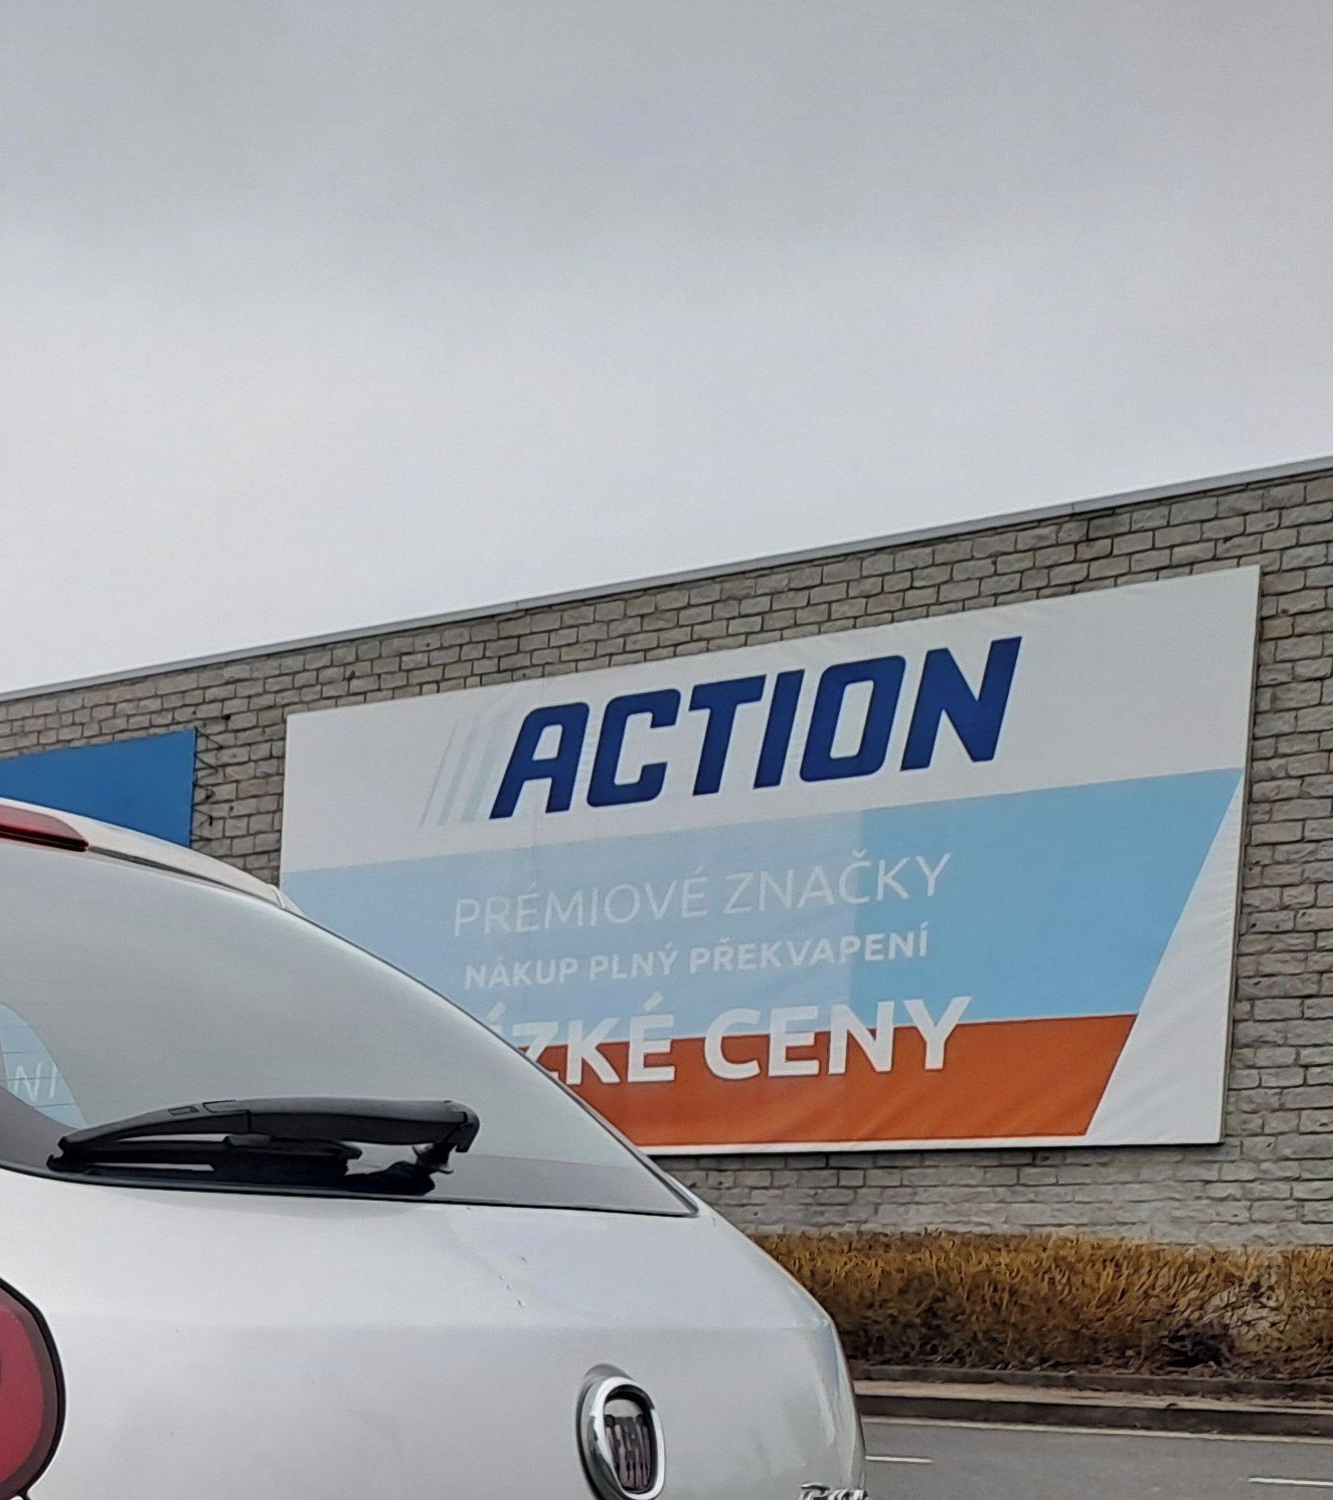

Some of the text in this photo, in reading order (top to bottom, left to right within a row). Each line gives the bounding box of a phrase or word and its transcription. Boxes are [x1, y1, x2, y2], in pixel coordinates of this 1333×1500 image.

[489, 636, 1022, 819] ACTION
[453, 849, 952, 938] PRÉMIOVÉ ZNAČKY
[464, 921, 931, 991] NÁKUP PLNÝ PŘEKVAPENÍ
[485, 990, 972, 1086] ZKÉ CENY
